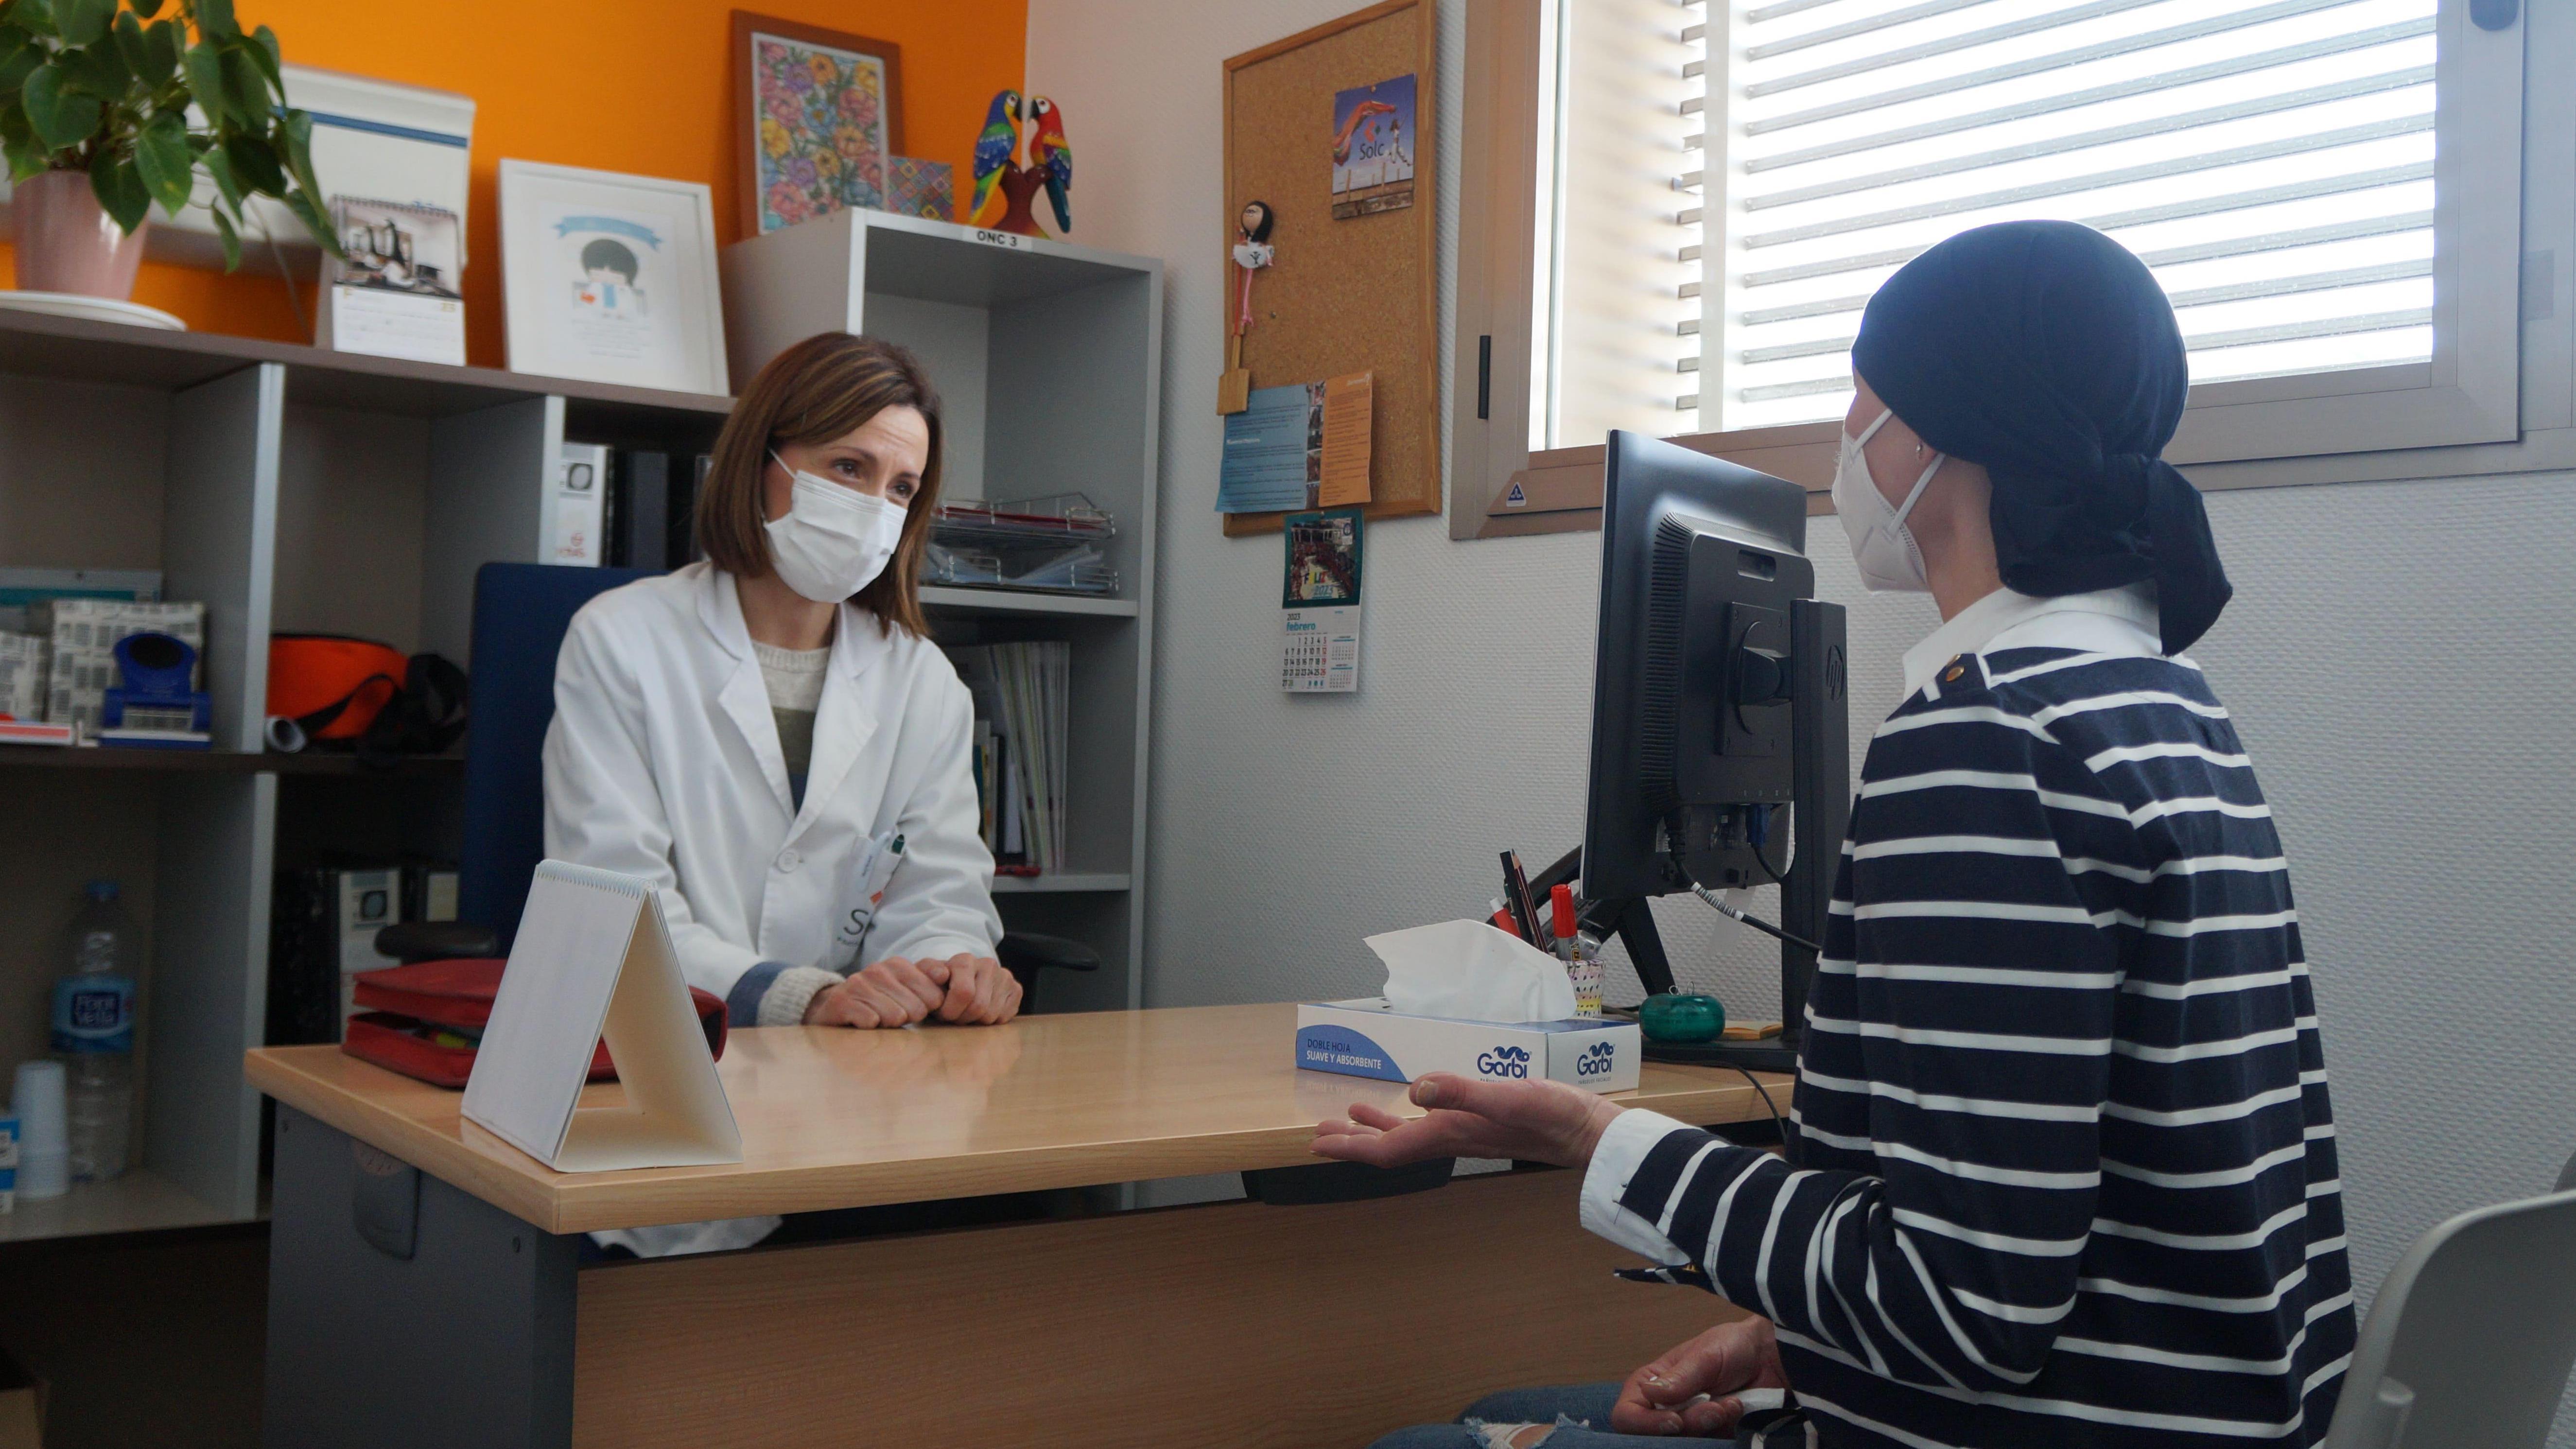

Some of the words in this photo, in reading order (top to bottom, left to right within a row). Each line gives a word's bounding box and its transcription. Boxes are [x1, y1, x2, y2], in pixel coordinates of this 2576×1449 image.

[1359, 141, 1384, 160] Solc
[977, 230, 1005, 244] ONC
[1010, 236, 1017, 247] 3
[1287, 622, 1316, 631] febrero
[1307, 1039, 1330, 1050] DOBLE
[1332, 1042, 1351, 1053] HOJA
[1306, 1050, 1328, 1063] SUAVE
[1330, 1054, 1335, 1063] Y
[1336, 1055, 1381, 1069] ABSORBENTE
[1477, 1051, 1527, 1079] Garbi
[1577, 1051, 1612, 1076] Garbi
